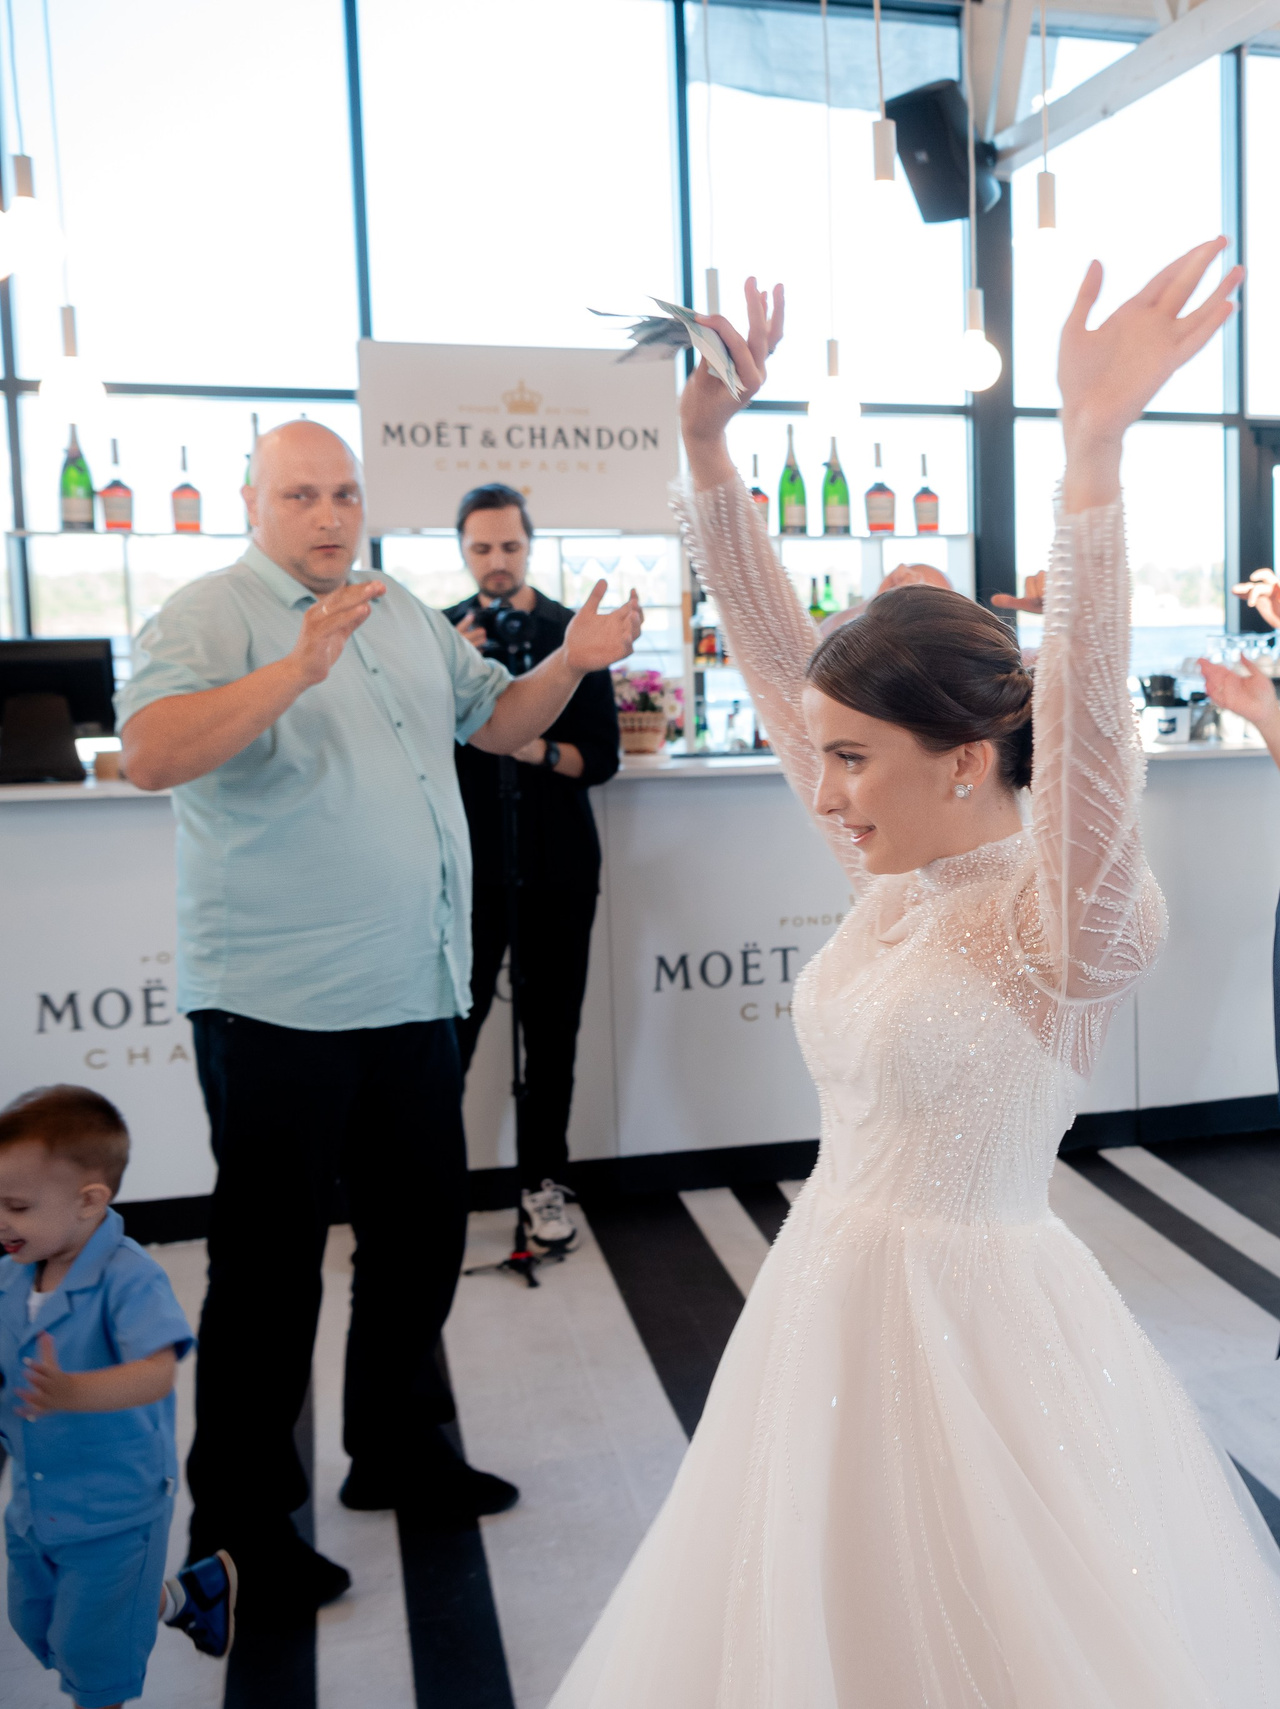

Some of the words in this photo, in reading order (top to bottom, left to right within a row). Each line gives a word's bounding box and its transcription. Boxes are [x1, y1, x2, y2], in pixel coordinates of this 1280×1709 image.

[381, 419, 472, 448] MOËT
[480, 428, 498, 449] &
[505, 424, 659, 452] CHANDON
[653, 942, 799, 993] MOËT
[36, 978, 172, 1034] MOË
